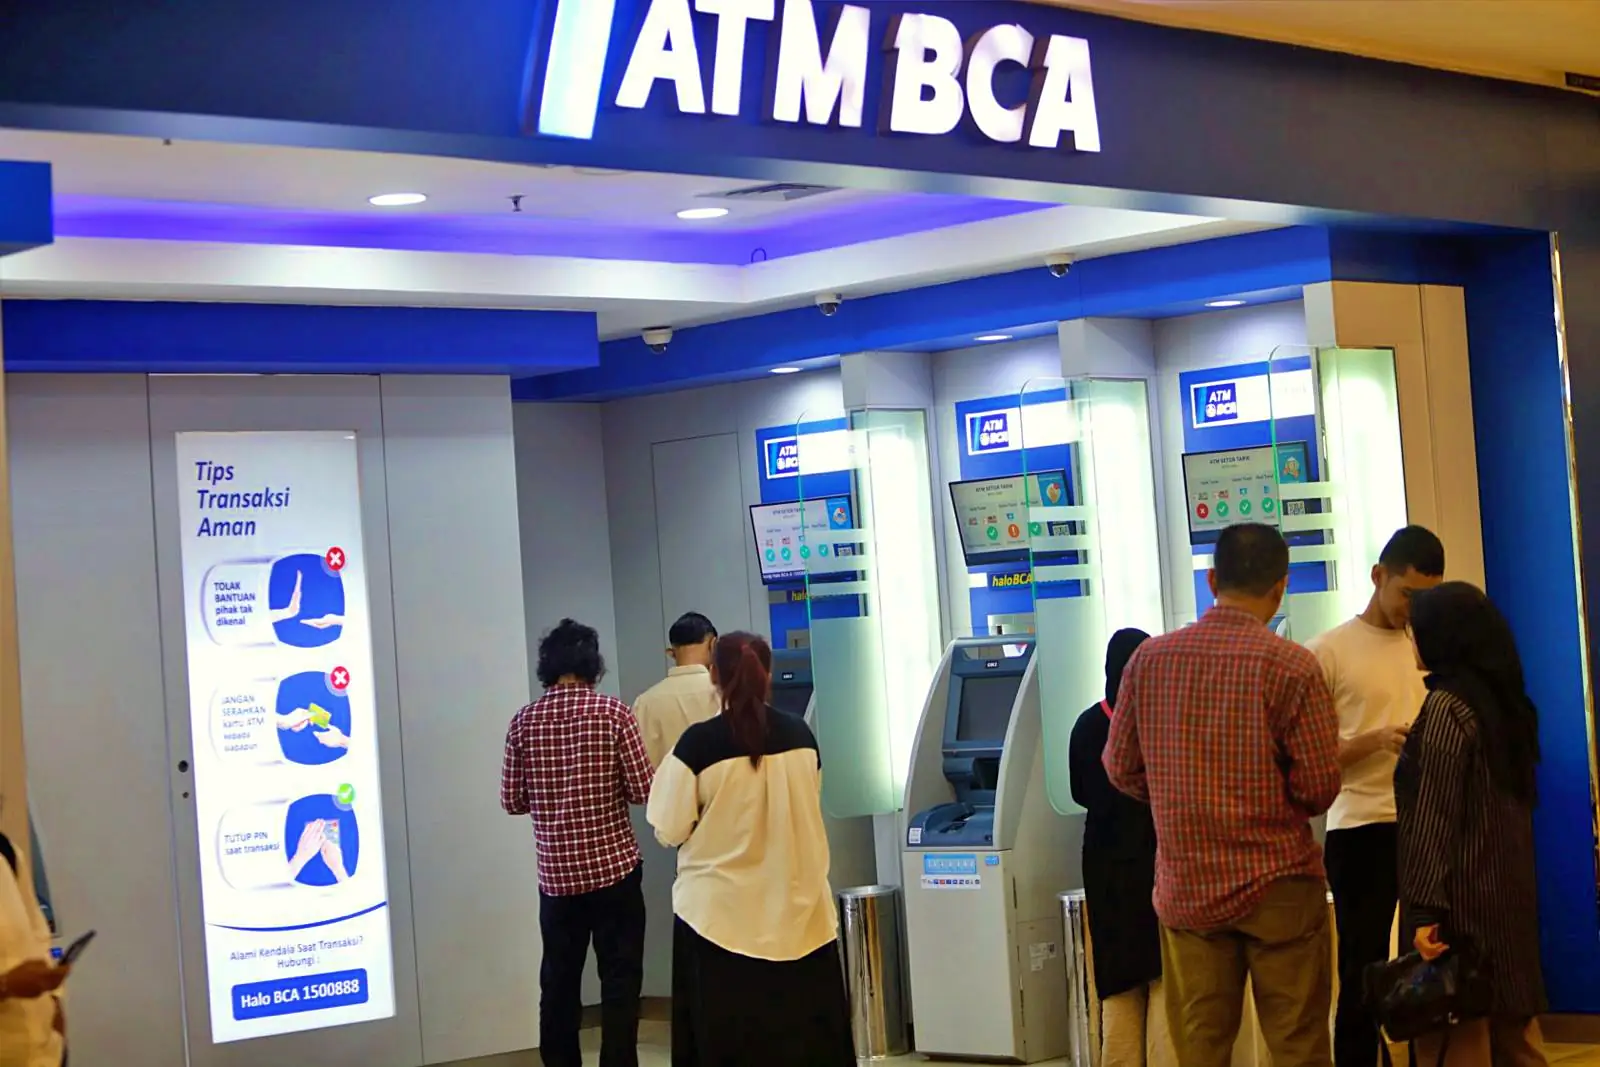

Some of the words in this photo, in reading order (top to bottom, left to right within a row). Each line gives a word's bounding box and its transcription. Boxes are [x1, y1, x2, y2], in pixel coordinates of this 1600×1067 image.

[615, 0, 871, 127] ATM
[889, 12, 1102, 153] BCA
[1209, 389, 1231, 403] ATM
[195, 461, 235, 485] Tips
[197, 487, 291, 509] Transaksi
[197, 517, 256, 537] Aman
[214, 582, 241, 591] TOLAK
[215, 592, 256, 603] BANTUAN
[224, 832, 252, 844] TUTUP
[259, 945, 295, 958] Kendala
[297, 943, 316, 953] Saat
[277, 957, 315, 969] Hubungi
[240, 992, 271, 1009] Halo
[273, 988, 300, 1004] BCA
[303, 979, 360, 1000] 1500888
